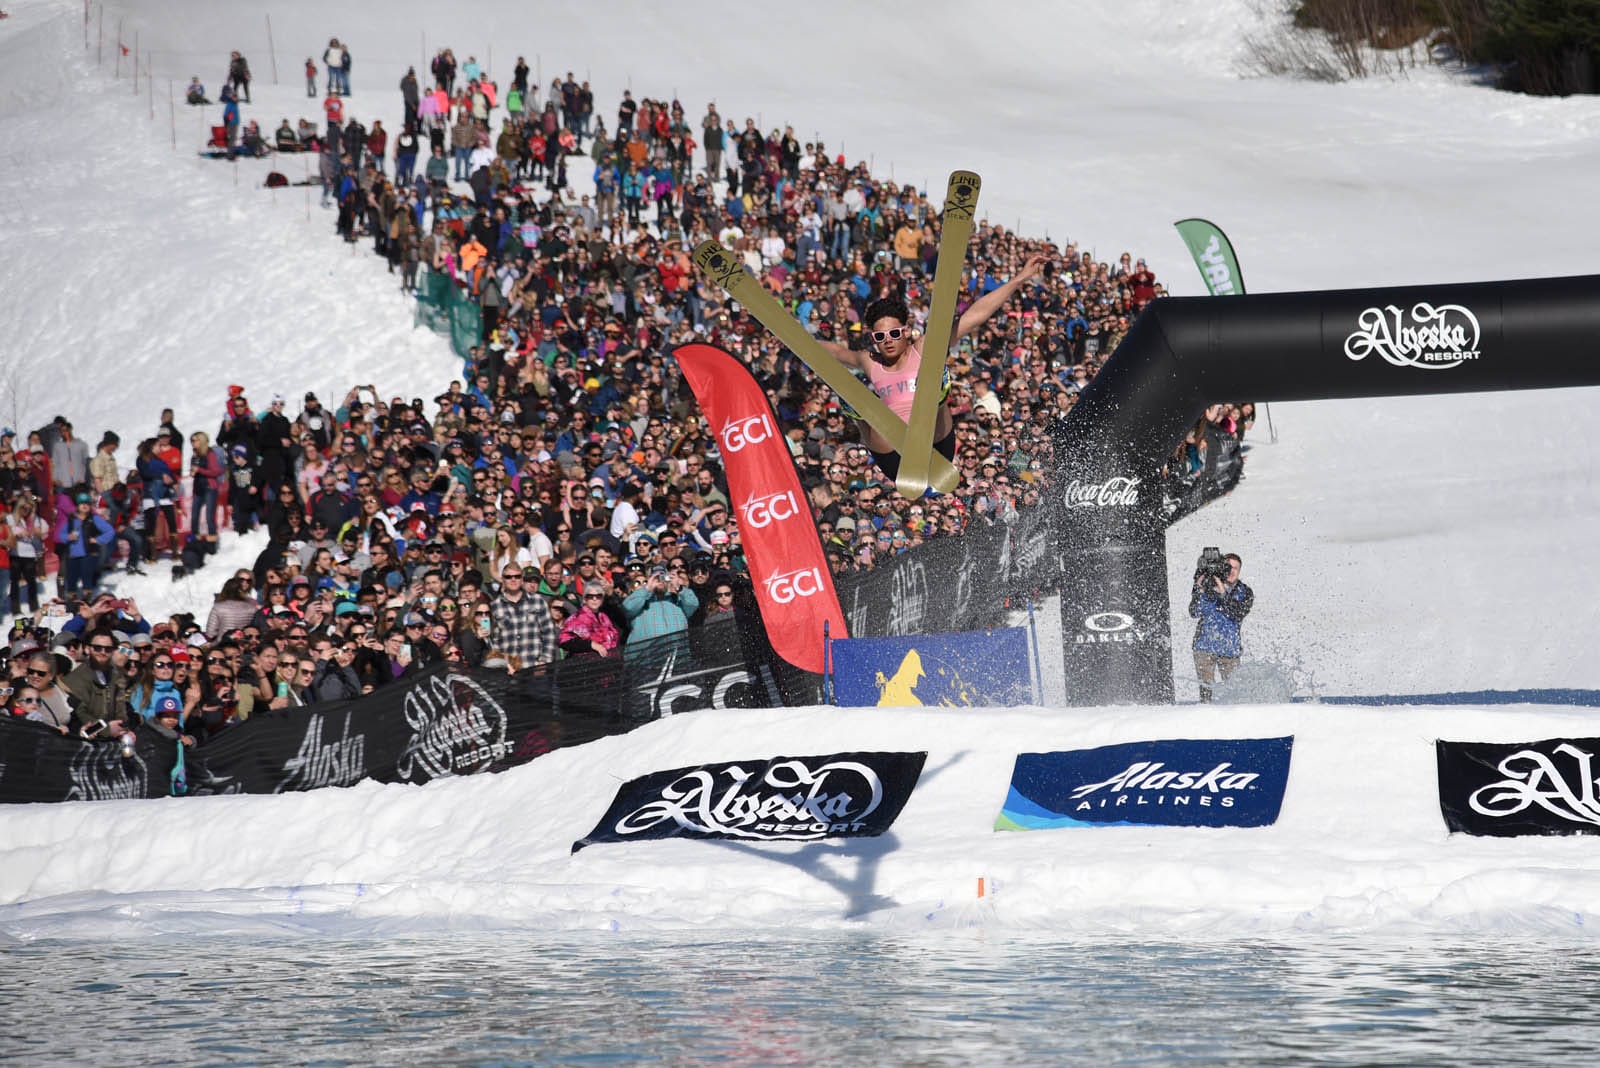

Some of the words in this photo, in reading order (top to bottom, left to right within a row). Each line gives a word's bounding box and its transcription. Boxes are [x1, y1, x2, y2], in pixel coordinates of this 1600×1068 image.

[950, 175, 980, 190] LINE
[1343, 302, 1481, 370] Alyeska
[1424, 350, 1481, 362] RESORT
[722, 413, 773, 453] GCI
[744, 490, 799, 529] GCI
[768, 567, 824, 604] GCI
[273, 711, 366, 794] Alaska
[456, 740, 516, 769] RESORT
[1069, 761, 1260, 800] Alaska
[614, 761, 883, 841] Alyeska
[1076, 795, 1235, 812] AIRLINES
[754, 822, 867, 834] RESORT
